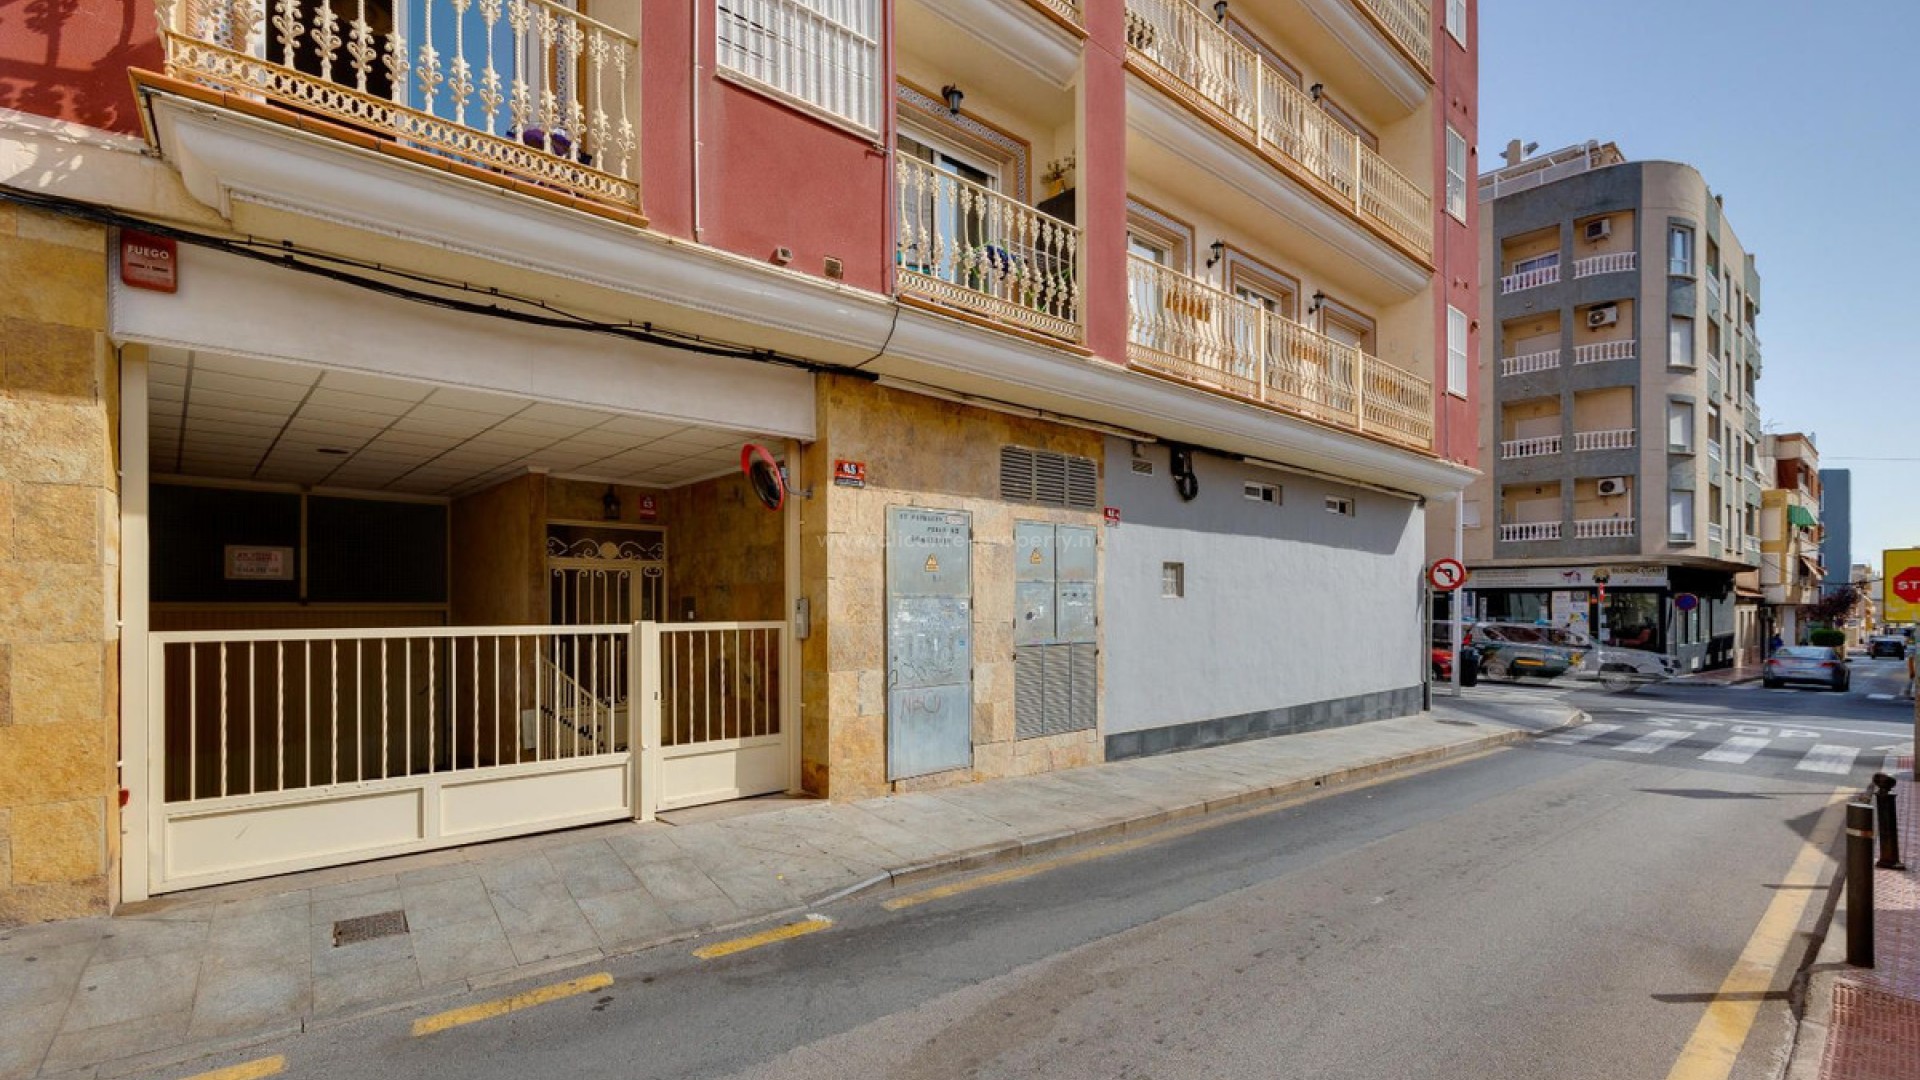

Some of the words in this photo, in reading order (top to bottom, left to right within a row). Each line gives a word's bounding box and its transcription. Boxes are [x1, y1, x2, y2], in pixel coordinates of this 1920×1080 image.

[127, 244, 169, 259] FUEGO
[1897, 581, 1920, 591] ST
[1647, 717, 1821, 738] STOP
